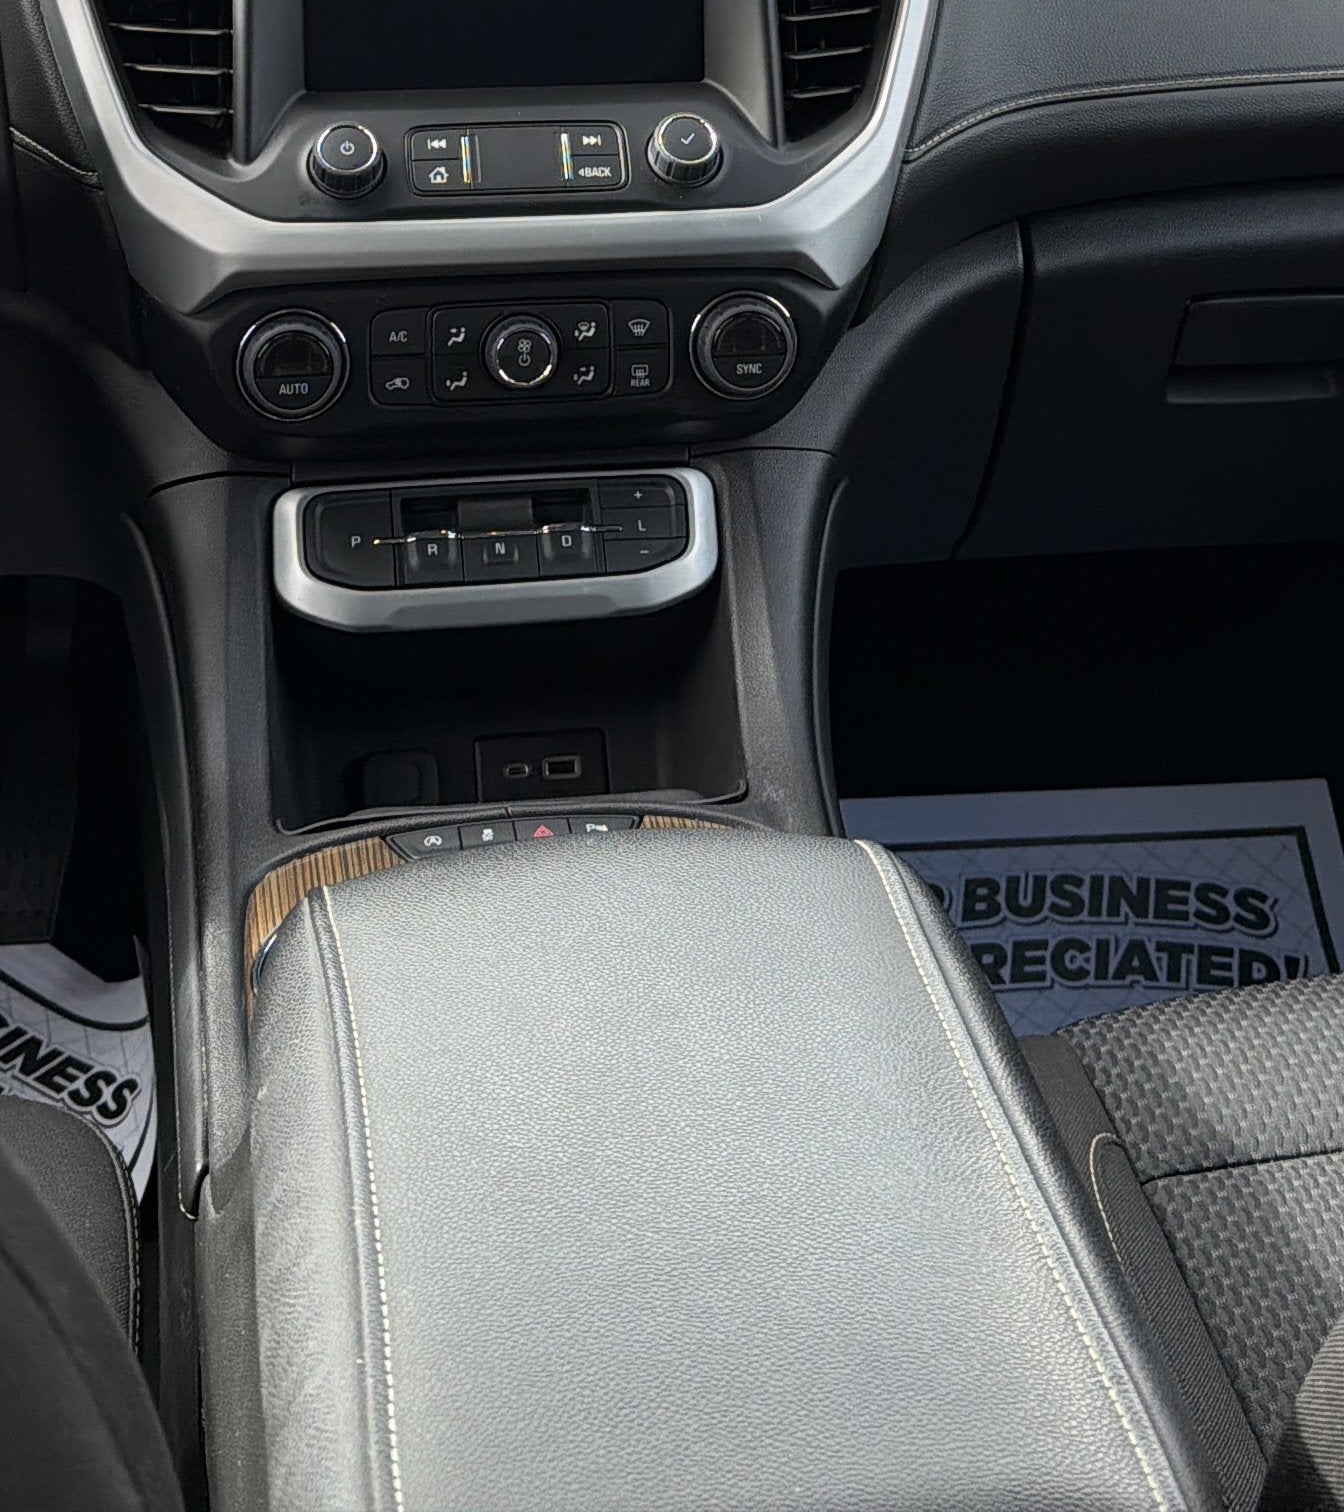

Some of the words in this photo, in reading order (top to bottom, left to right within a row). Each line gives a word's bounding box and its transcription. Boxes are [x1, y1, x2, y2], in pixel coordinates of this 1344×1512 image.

[585, 165, 612, 179] BACK
[388, 329, 408, 344] A/C
[735, 361, 763, 376] SYNC
[278, 382, 309, 396] AUTO
[630, 378, 651, 388] REAR
[638, 519, 646, 532] L
[351, 536, 361, 548] P
[562, 534, 572, 548] D
[428, 543, 438, 556] R
[495, 542, 506, 555] N
[962, 874, 1274, 930] BUSINESS
